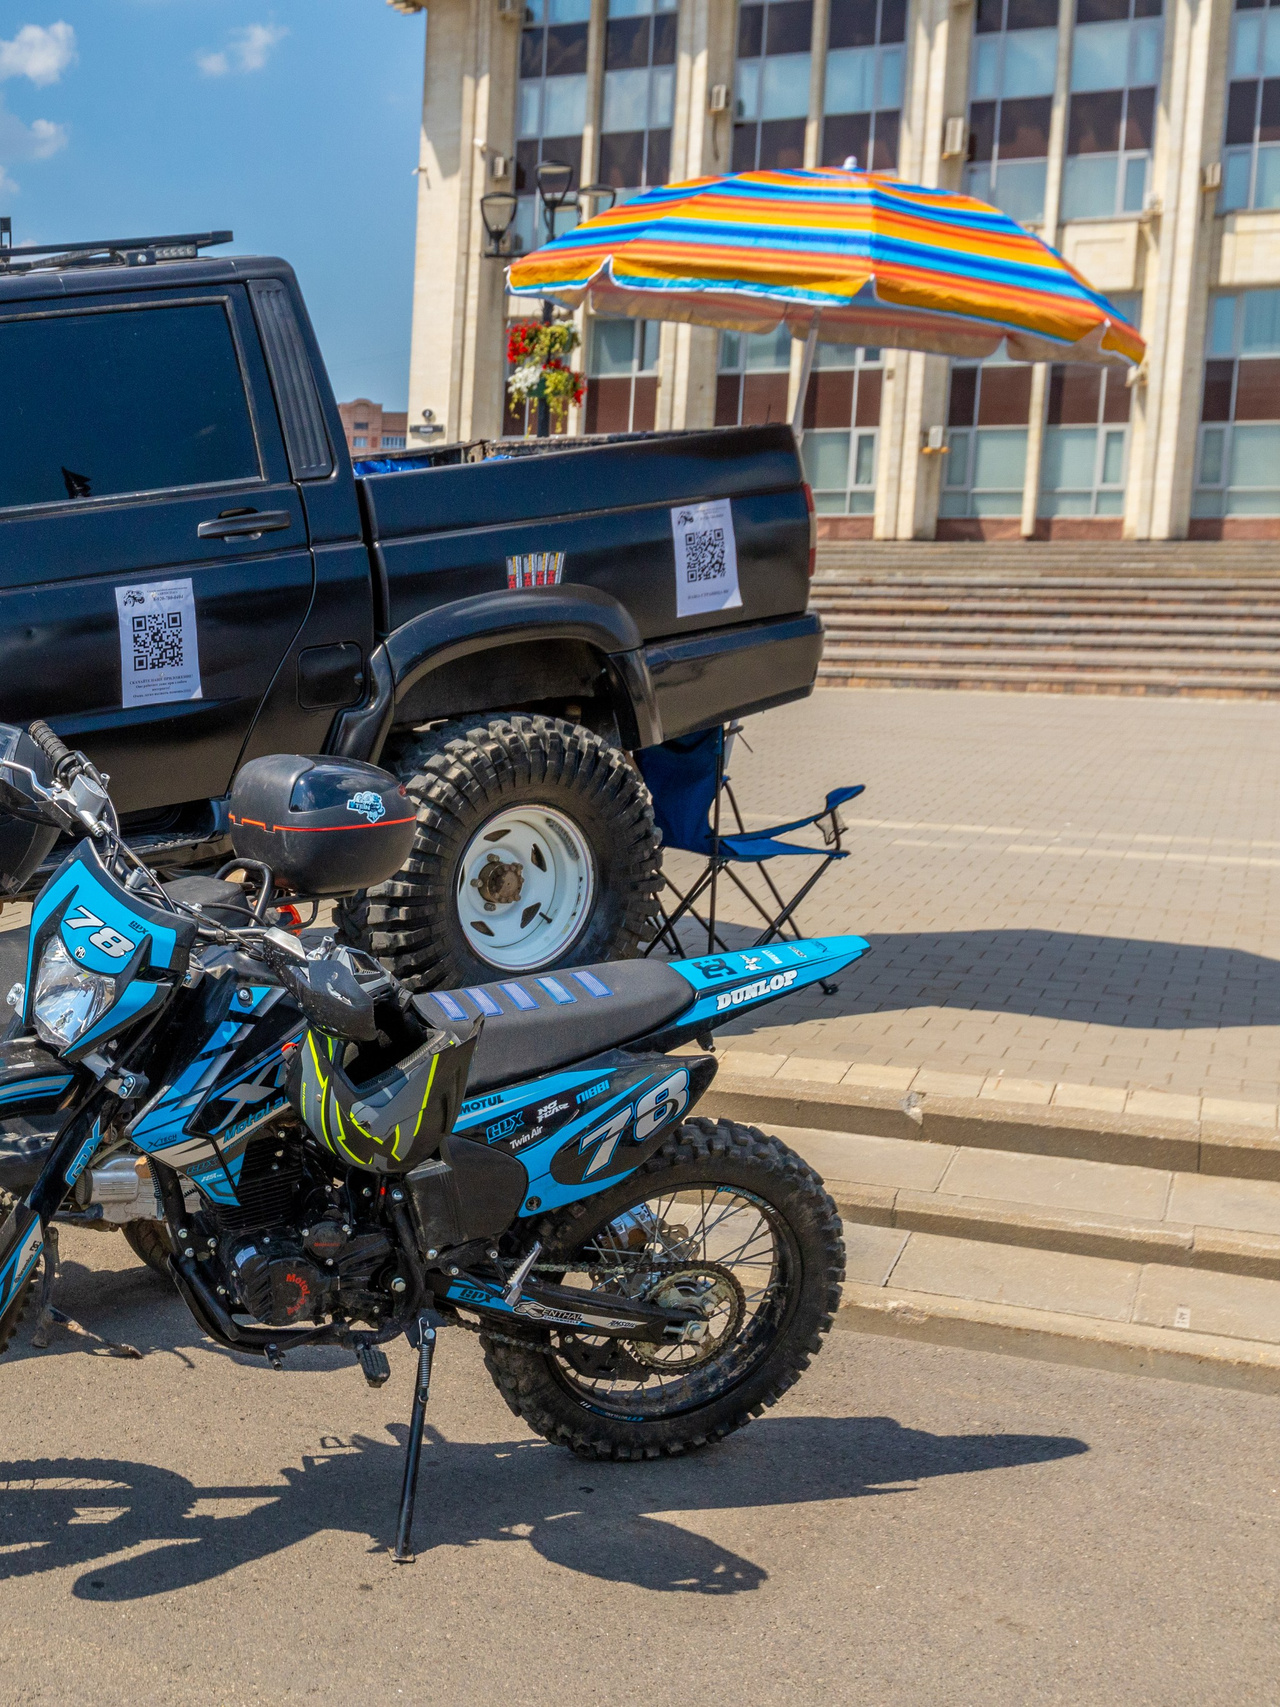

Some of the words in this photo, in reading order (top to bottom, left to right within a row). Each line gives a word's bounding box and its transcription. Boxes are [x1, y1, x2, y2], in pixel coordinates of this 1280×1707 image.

[64, 905, 136, 958] 78
[716, 969, 798, 1011] DUNLOP
[223, 1095, 289, 1144] MotoLa
[460, 1095, 504, 1116] MOTUL
[578, 1068, 690, 1181] 78
[509, 1135, 531, 1150] Twin
[531, 1126, 544, 1139] Air
[286, 1273, 311, 1316] MotoLand
[607, 1320, 636, 1329] AMSOIL
